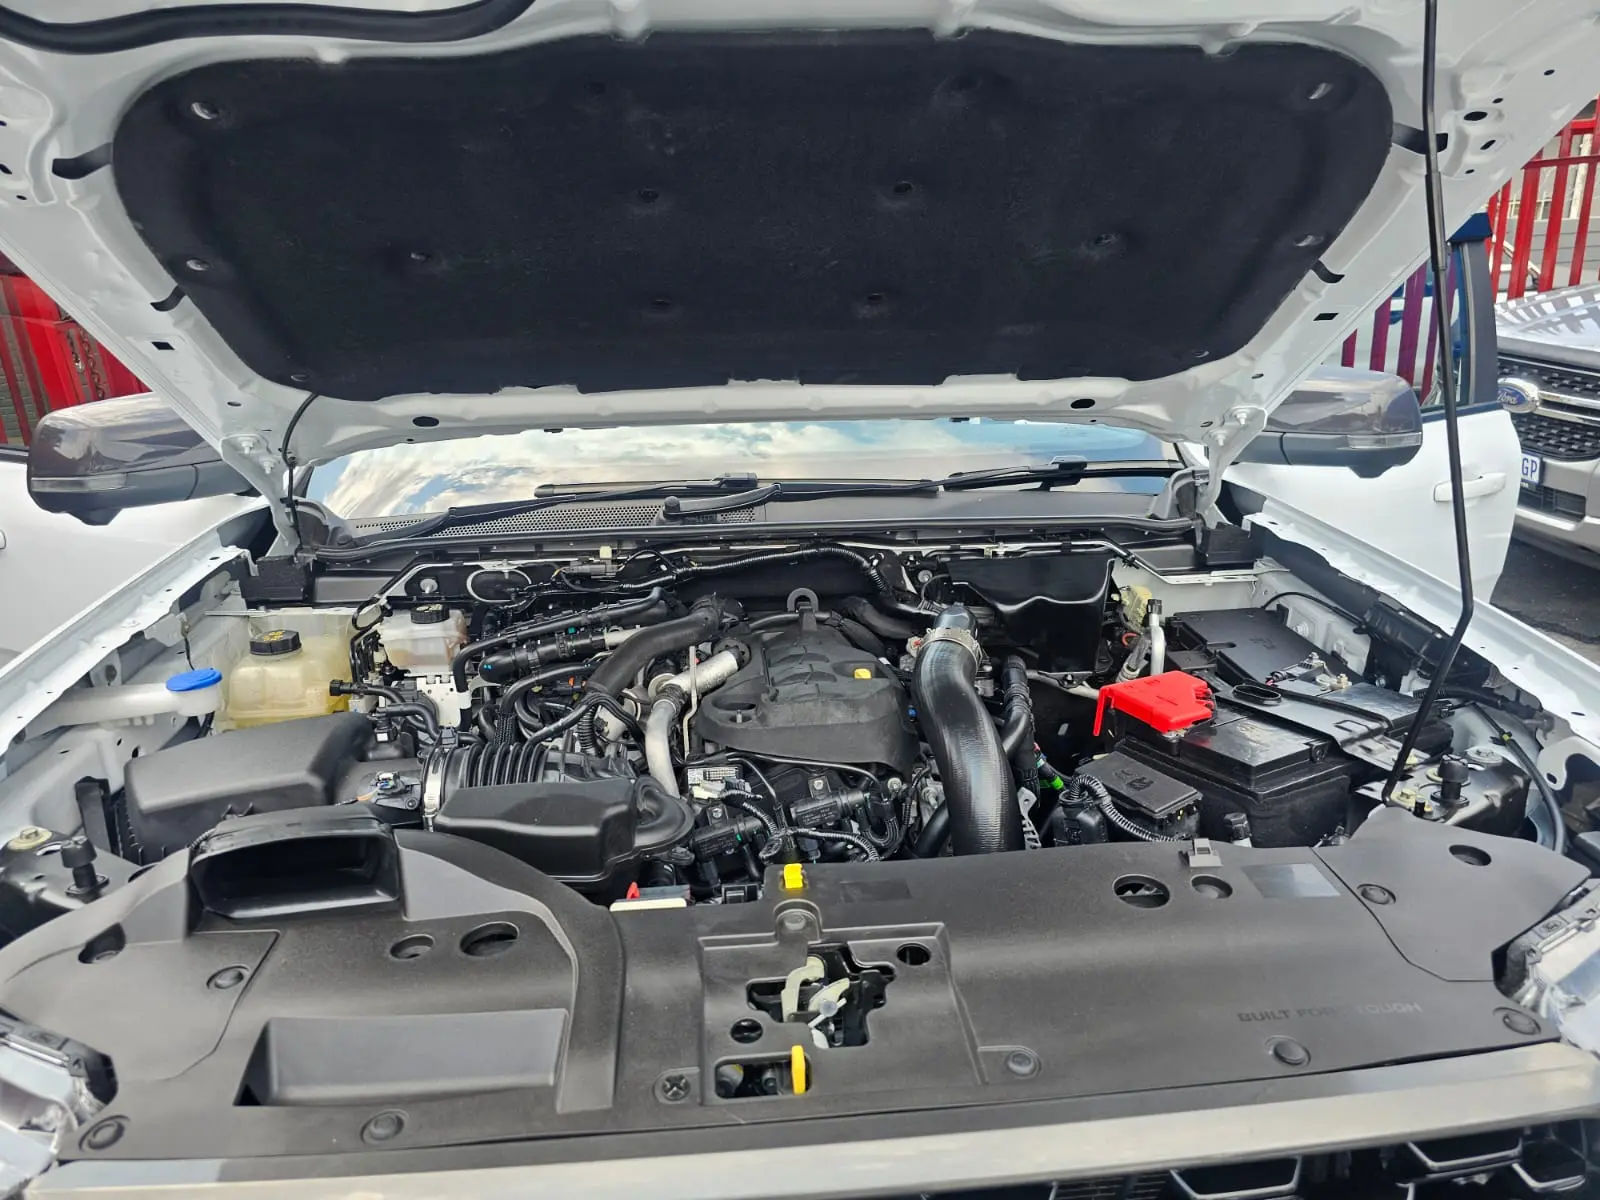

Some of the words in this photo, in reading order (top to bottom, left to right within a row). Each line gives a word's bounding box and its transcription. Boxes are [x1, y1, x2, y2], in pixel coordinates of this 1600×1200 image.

[1521, 457, 1538, 478] GP
[1237, 1008, 1291, 1022] BUILT
[1297, 1004, 1349, 1018] FOR
